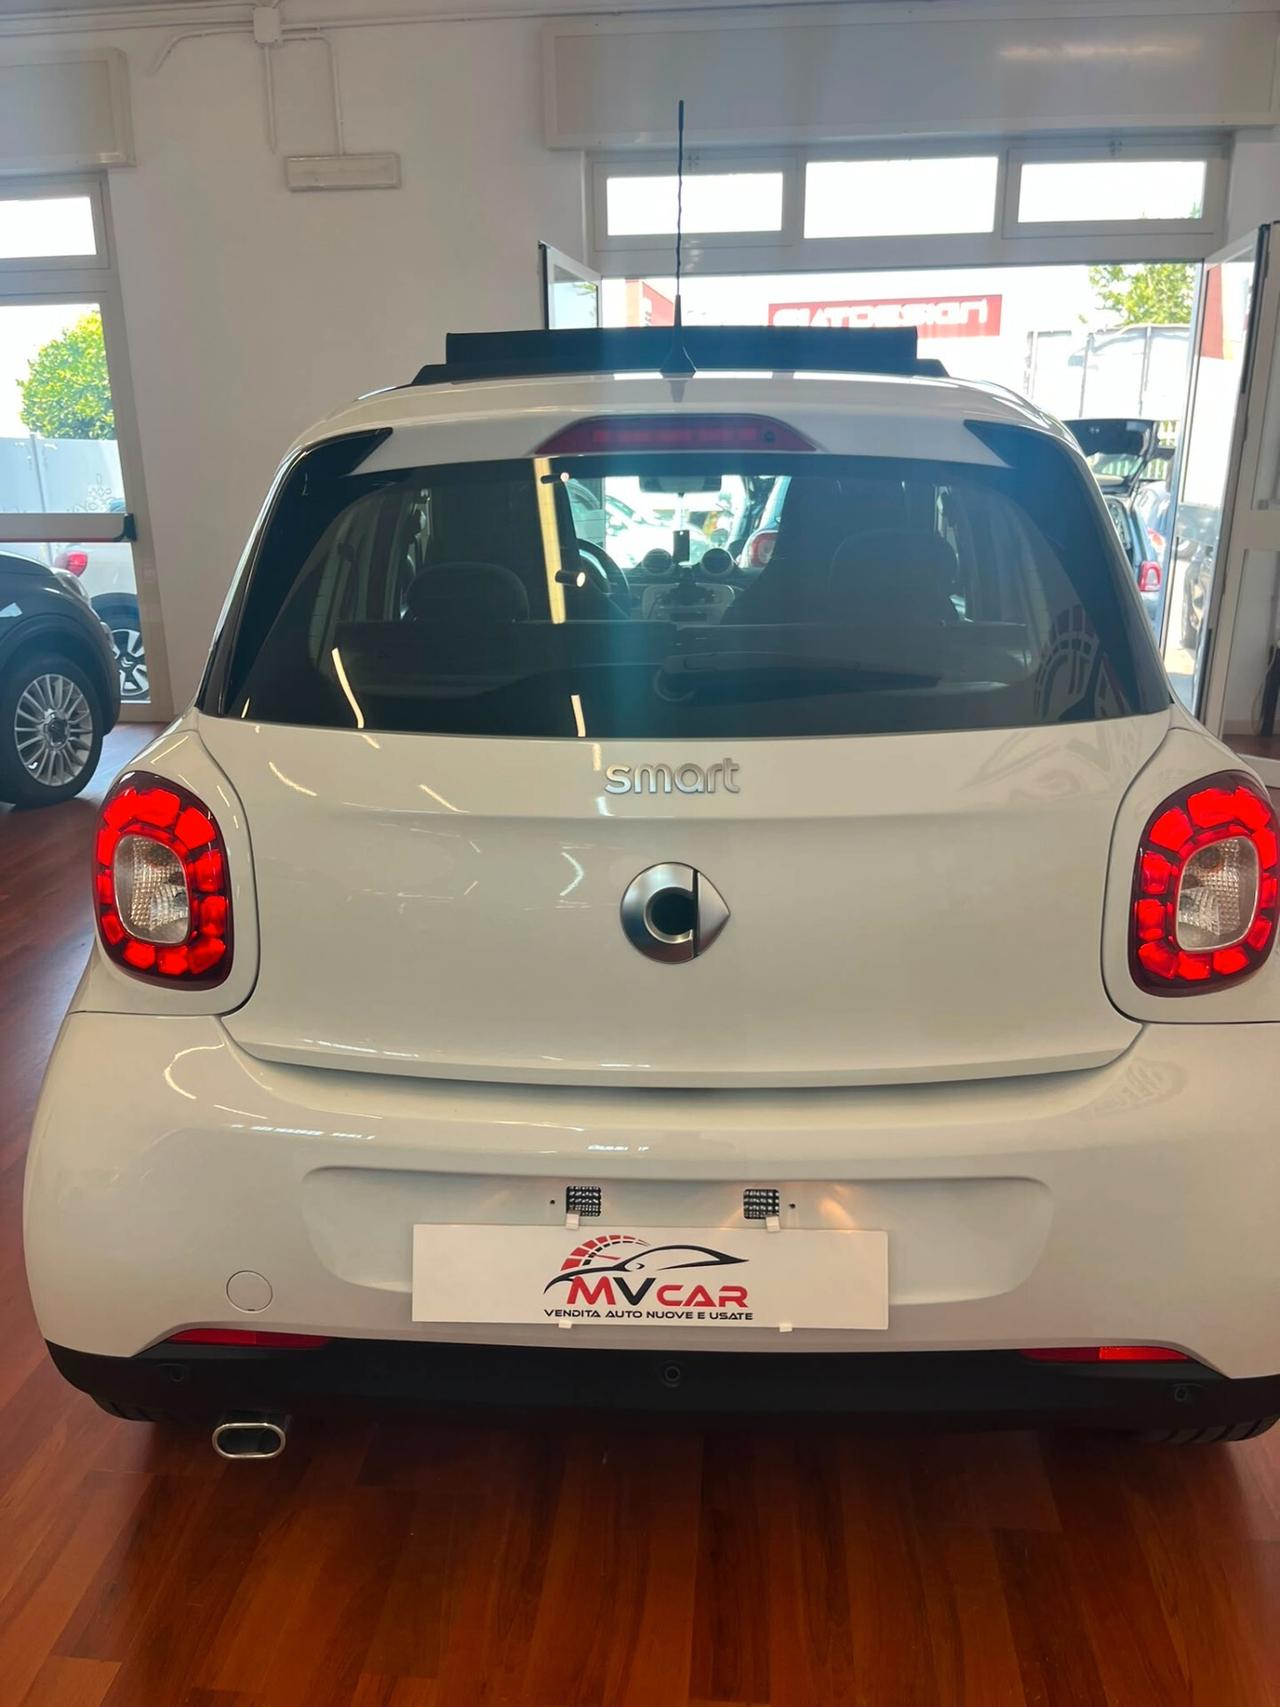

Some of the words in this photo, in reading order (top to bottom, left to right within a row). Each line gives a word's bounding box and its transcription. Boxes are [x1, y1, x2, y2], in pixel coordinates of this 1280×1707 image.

[604, 757, 741, 795] smart
[544, 1309, 601, 1318] VENDITA
[605, 1310, 643, 1319] AUTO
[646, 1311, 693, 1320] NUOVE
[697, 1311, 705, 1320] E
[709, 1312, 753, 1321] USATE
